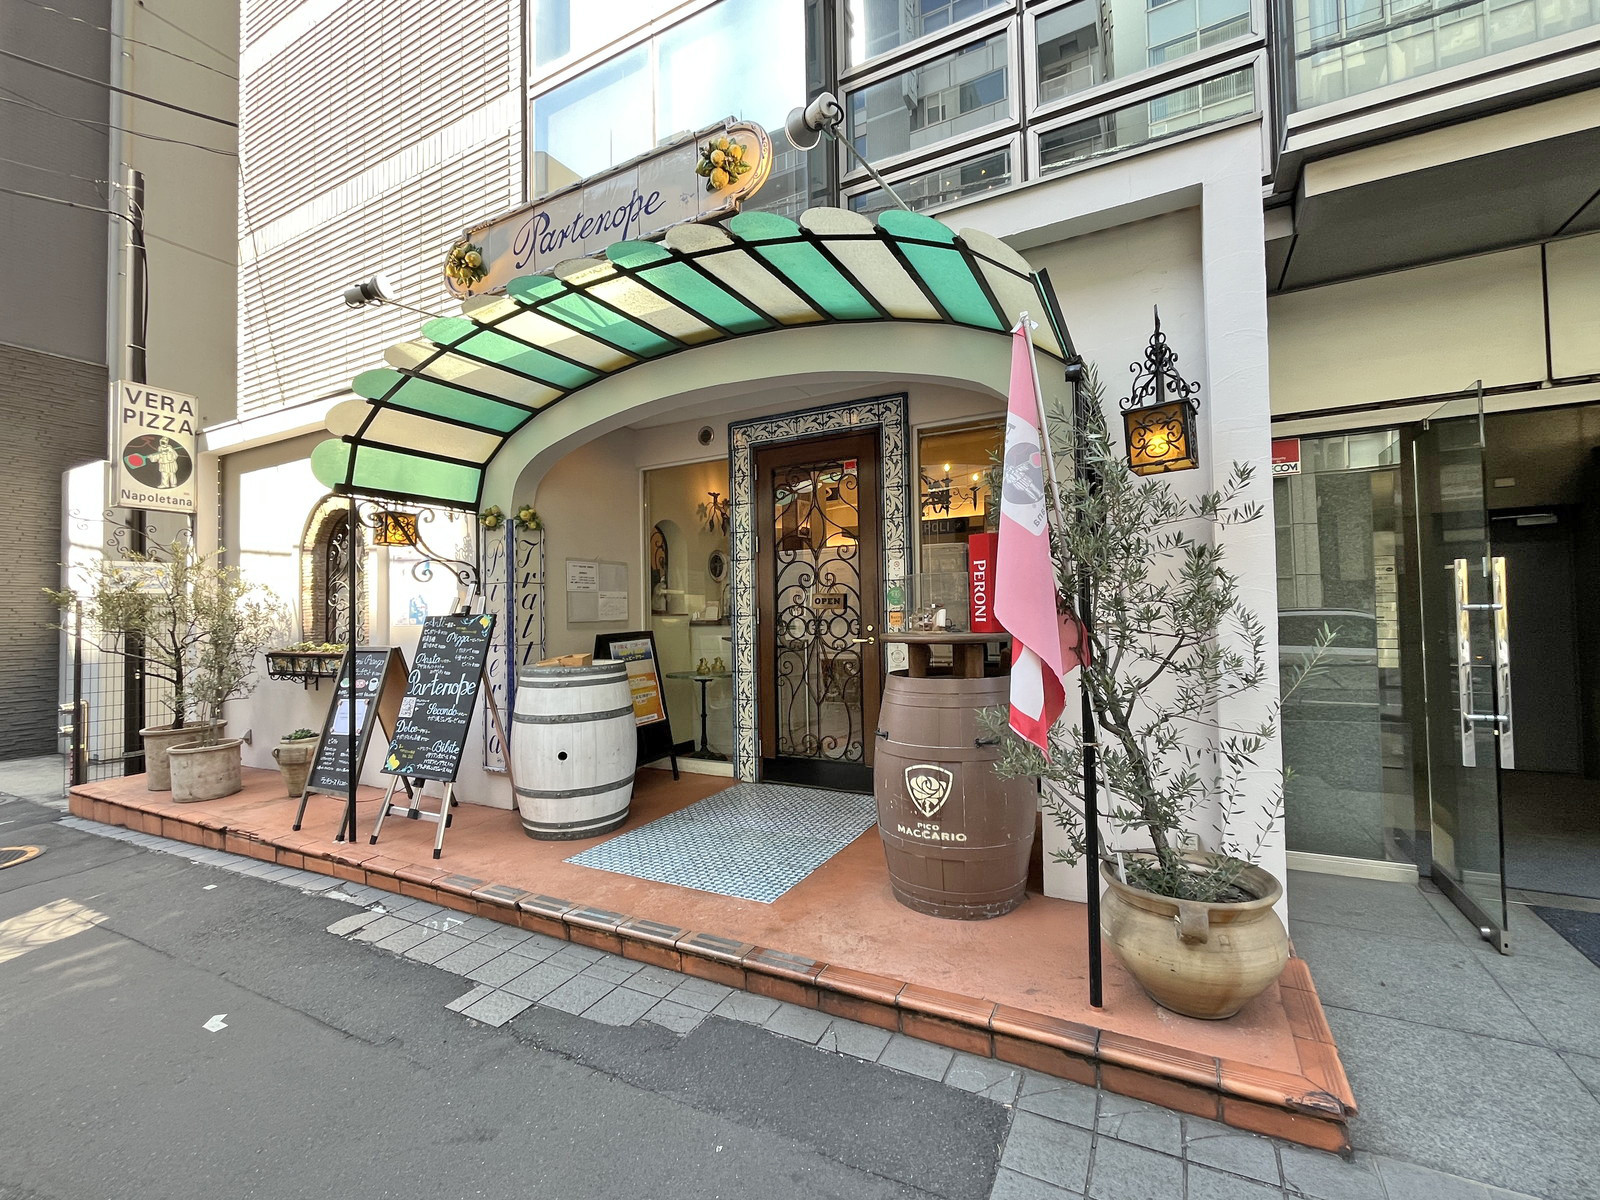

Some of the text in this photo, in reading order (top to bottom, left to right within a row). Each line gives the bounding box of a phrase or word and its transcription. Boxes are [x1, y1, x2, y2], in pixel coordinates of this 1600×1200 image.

[513, 188, 666, 270] Partenope
[125, 387, 194, 417] VERA
[123, 407, 194, 436] PIZZA
[1272, 463, 1298, 473] COM
[121, 489, 193, 507] Napoletana
[973, 560, 987, 622] PERONI
[814, 597, 841, 605] OPEN
[407, 669, 477, 705] Partenope
[431, 740, 460, 754] Bibite
[897, 823, 967, 842] MACCARIO
[917, 822, 940, 831] PICO
